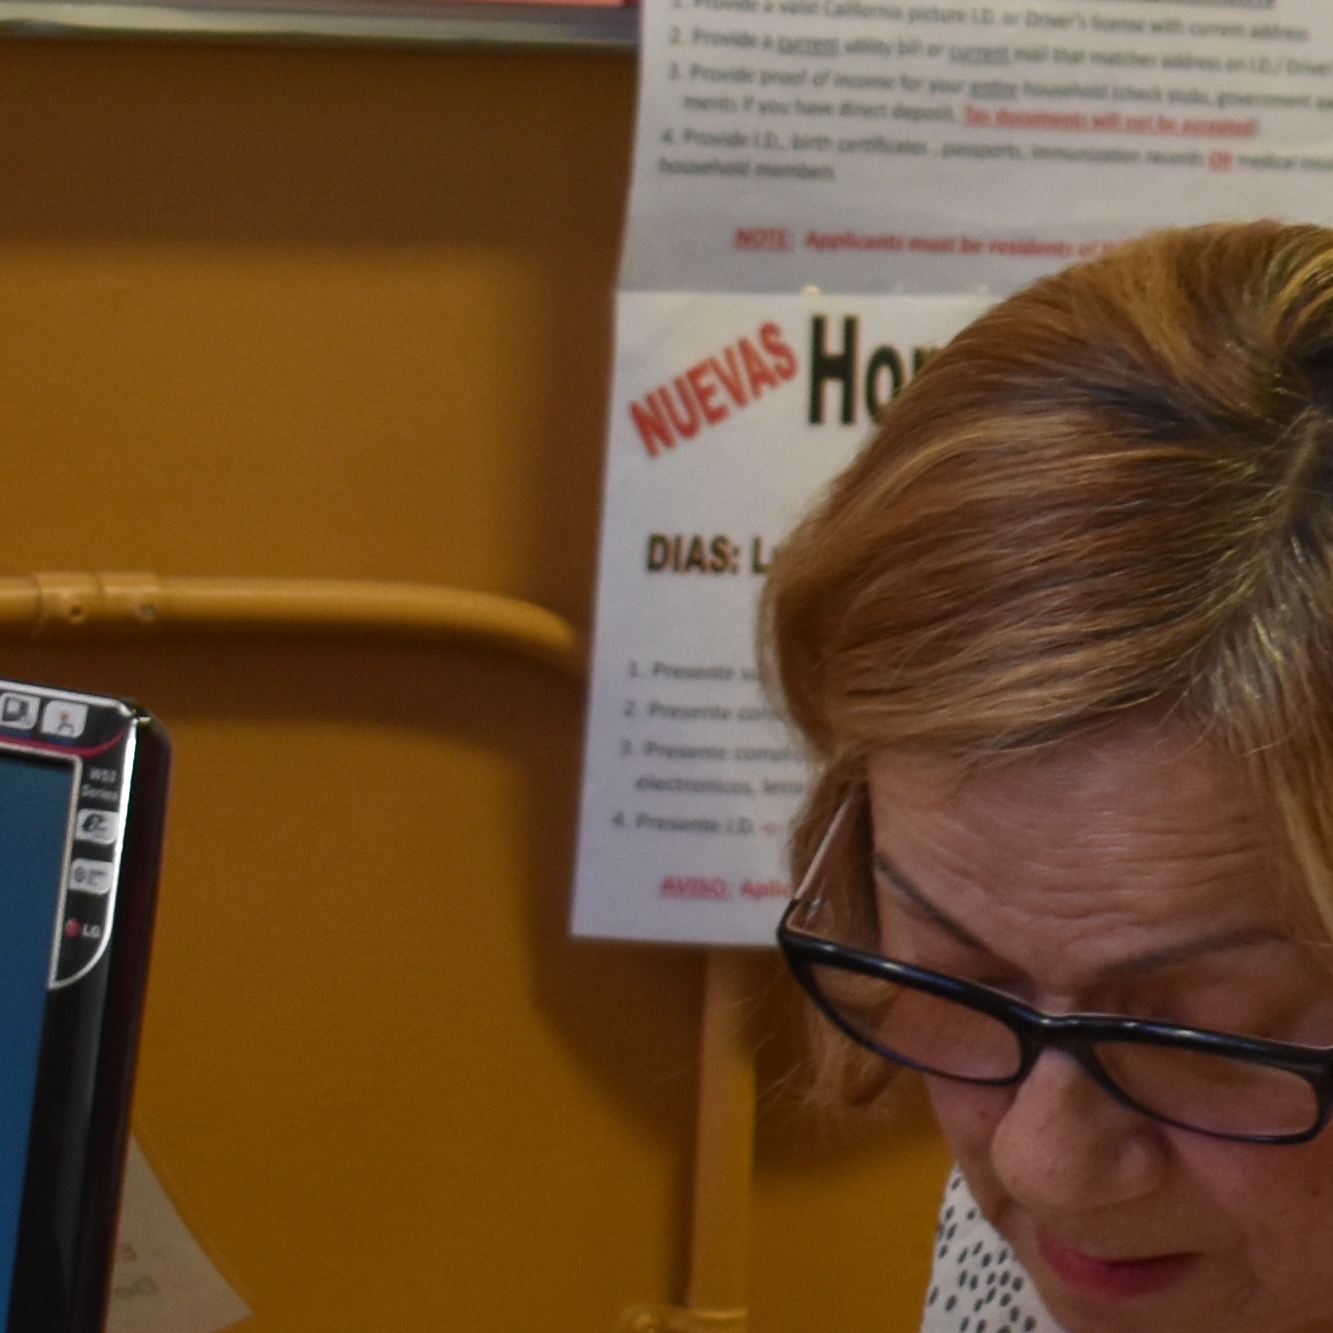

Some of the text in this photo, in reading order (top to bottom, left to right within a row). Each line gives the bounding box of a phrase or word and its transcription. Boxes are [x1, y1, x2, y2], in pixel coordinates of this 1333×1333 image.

[803, 228, 902, 255] Applicants
[909, 234, 956, 254] must
[960, 234, 982, 255] be
[989, 234, 1073, 257] residents
[627, 319, 801, 459] NUEVAS
[645, 532, 740, 575] DIAS:
